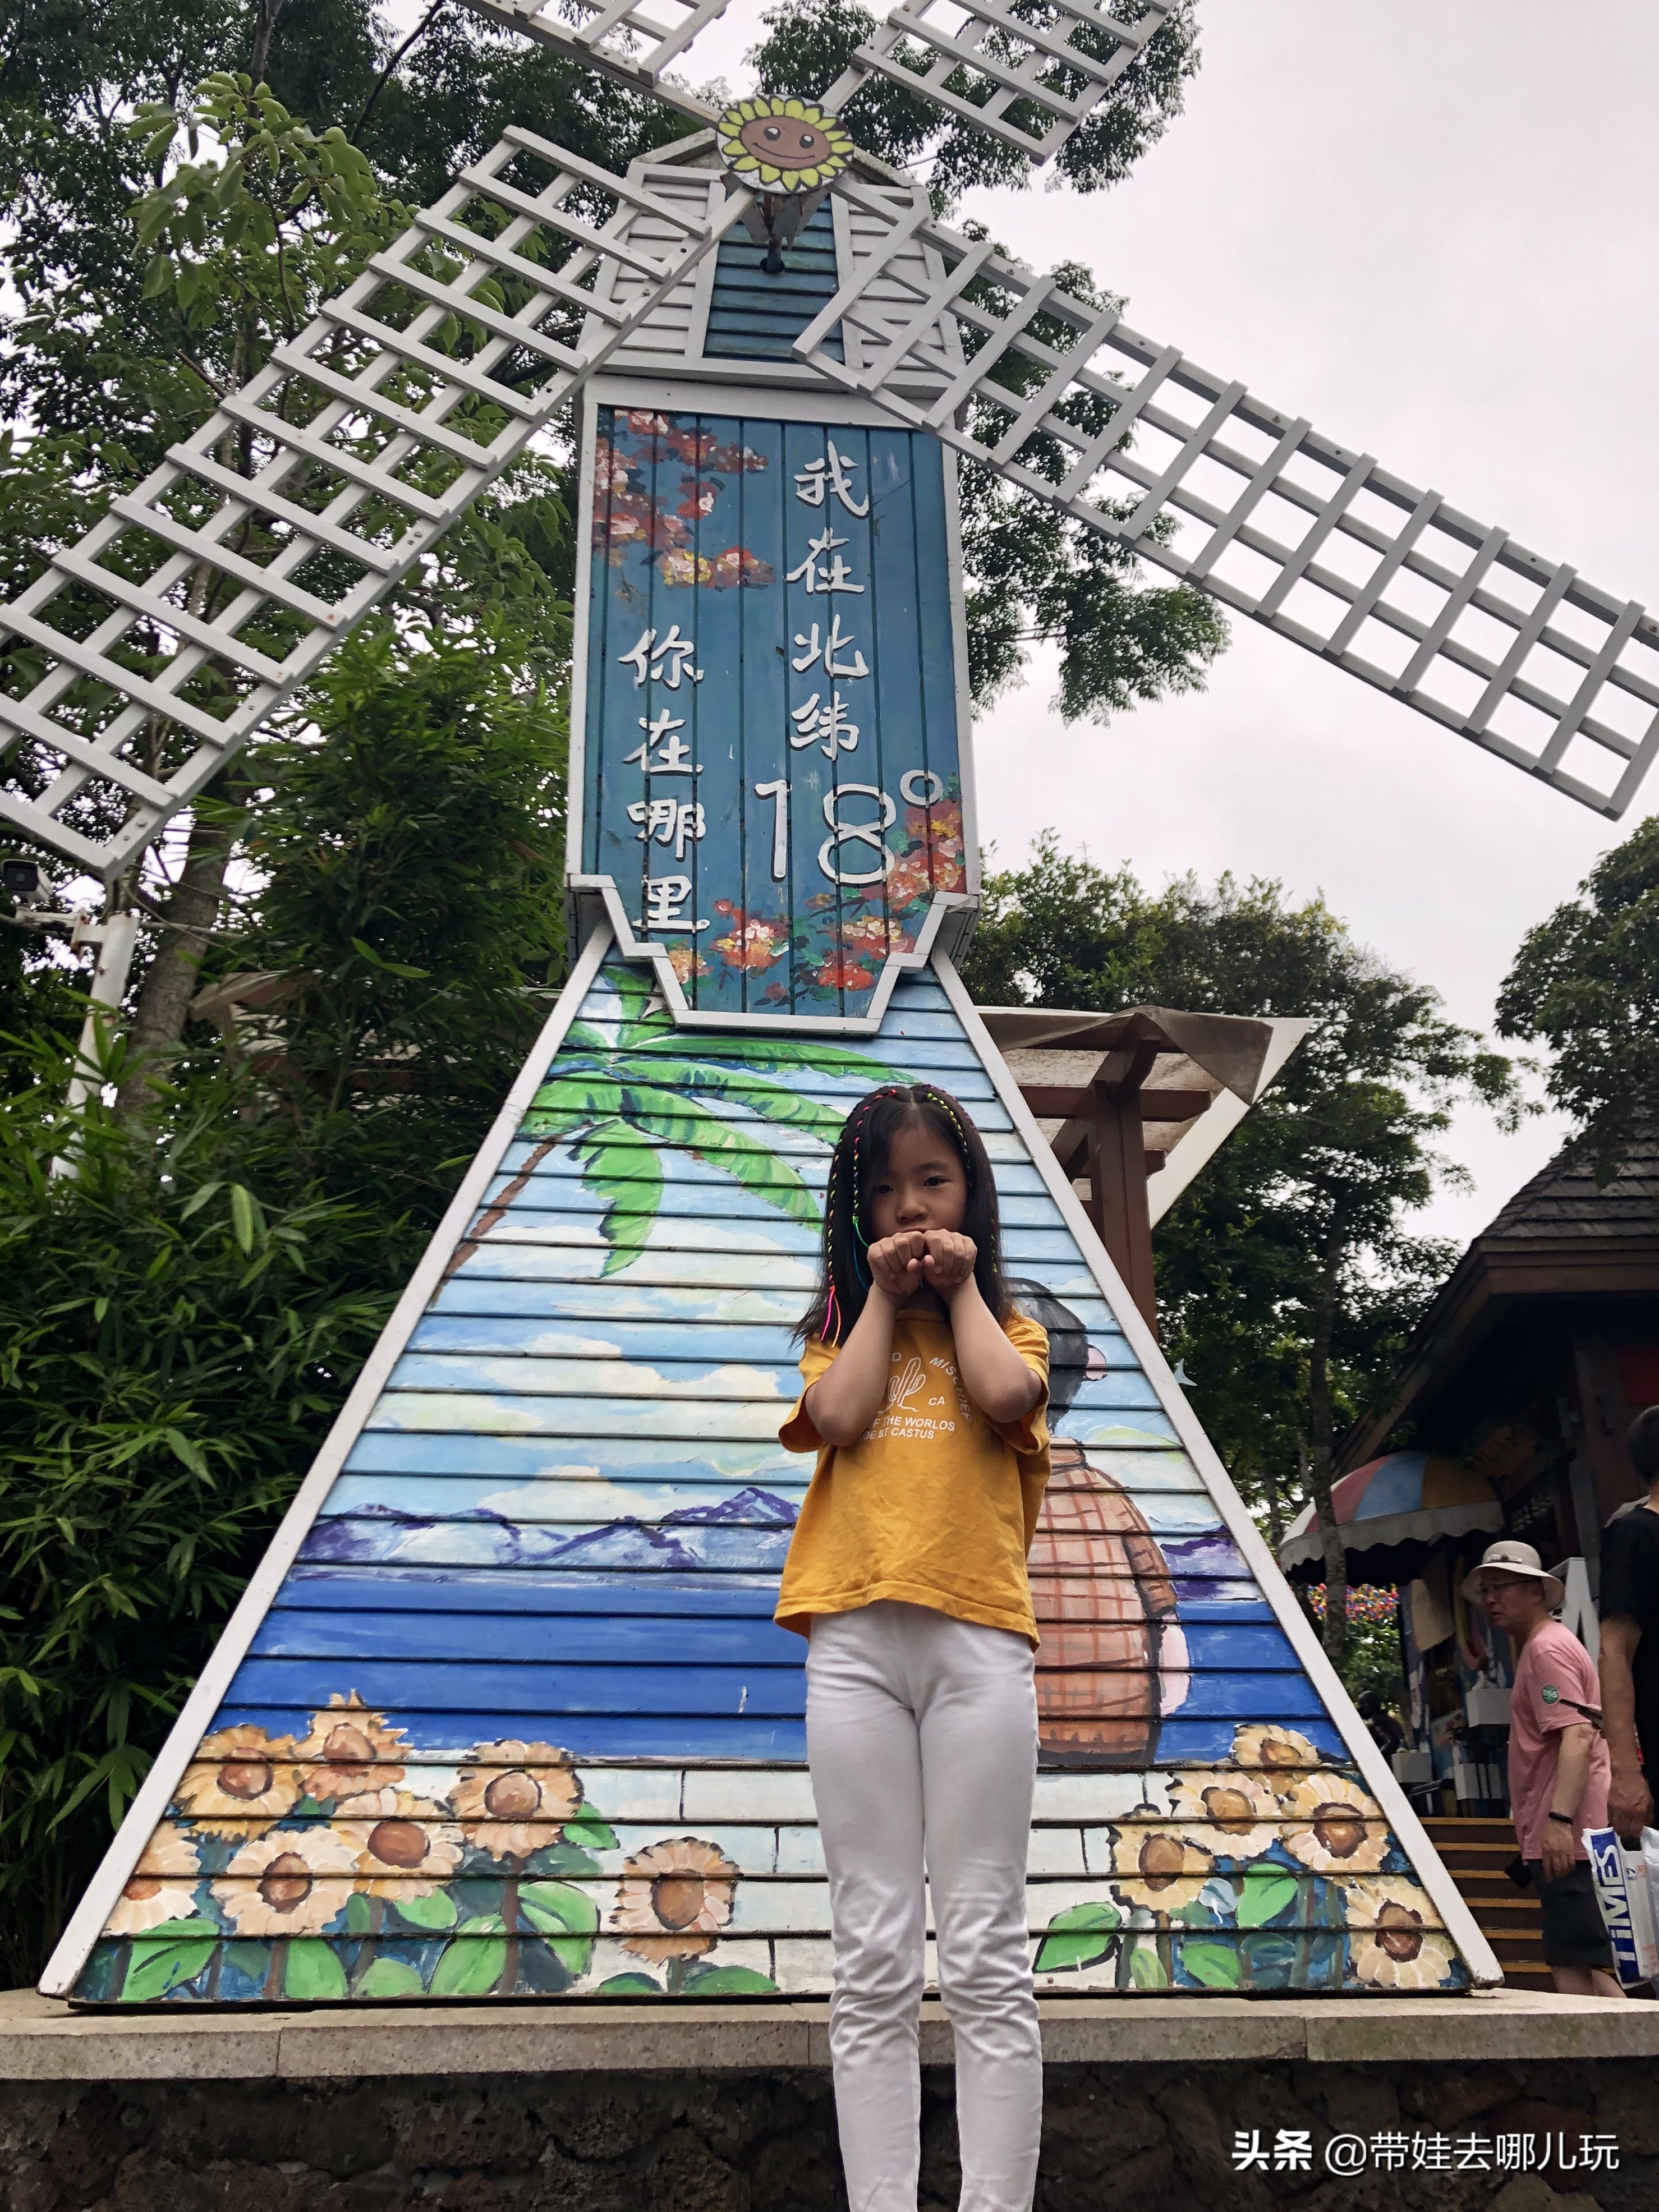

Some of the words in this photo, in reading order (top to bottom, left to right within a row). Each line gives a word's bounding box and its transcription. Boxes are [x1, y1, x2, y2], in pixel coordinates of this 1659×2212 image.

[787, 440, 870, 761] 我在北纬
[618, 624, 710, 934] 你在哪里
[929, 1396, 945, 1406] CA
[883, 1415, 903, 1427] THE
[891, 1427, 934, 1439] CASTUS
